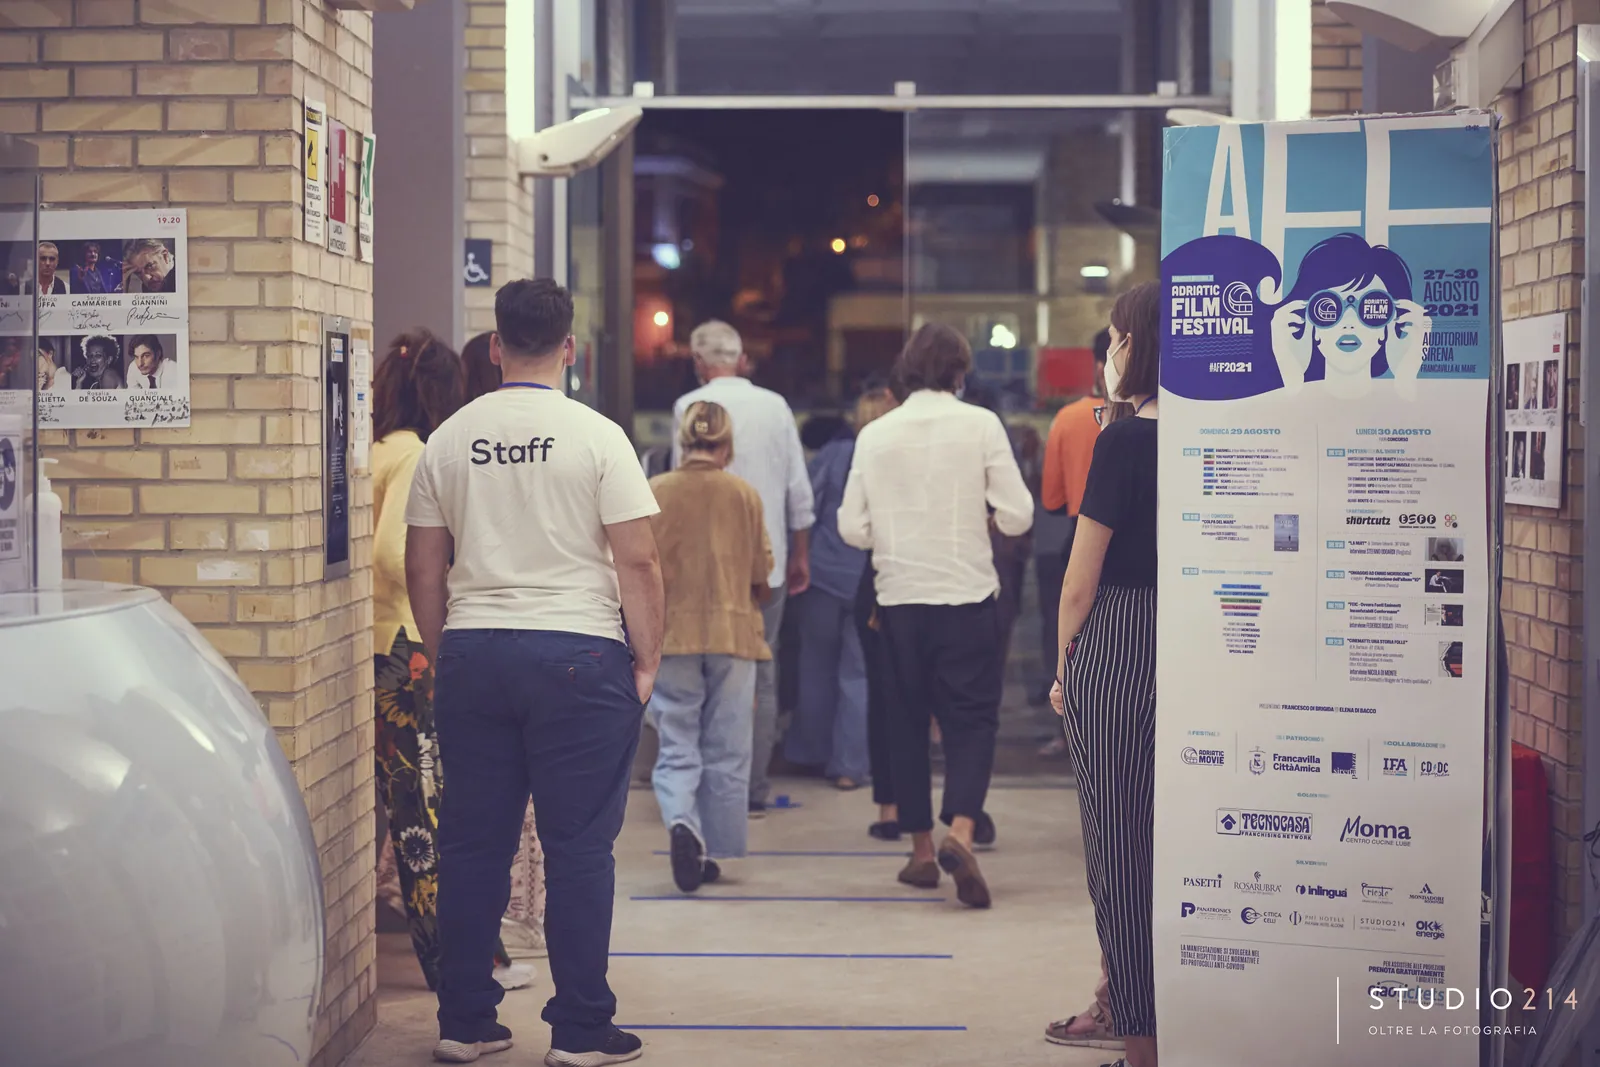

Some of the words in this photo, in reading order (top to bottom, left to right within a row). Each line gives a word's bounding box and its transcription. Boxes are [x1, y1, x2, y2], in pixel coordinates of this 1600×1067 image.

[1172, 285, 1220, 296] ADRIATIC
[1424, 281, 1479, 303] AGOSTO
[1172, 297, 1220, 317] FILM
[1364, 304, 1389, 314] FILM
[1423, 304, 1479, 316] 2021
[1171, 317, 1254, 335] FESTIVAL
[1422, 331, 1478, 347] AUDITORIUM
[1421, 347, 1454, 361] SIRENA
[470, 436, 556, 466] Staff
[1346, 516, 1391, 525] shortcutz
[1199, 750, 1225, 758] ADRIATIC
[1272, 754, 1320, 764] Francavilla
[1199, 757, 1225, 765] MOVIE
[1383, 758, 1408, 771] IFA
[1272, 762, 1320, 773] CittàAmica
[1241, 812, 1312, 834] TECNOCASA
[1340, 815, 1411, 842] Moma
[1346, 837, 1370, 845] CENTRO
[1183, 874, 1222, 889] PASETTI
[1234, 881, 1281, 892] ROSARUBRA
[1308, 885, 1347, 899] inlingua
[1409, 894, 1444, 902] MONDADORI
[1196, 906, 1232, 914] PANATRONICS
[1360, 917, 1405, 927] STUDIO214
[1416, 920, 1433, 931] OK
[1416, 930, 1445, 940] energie
[1186, 944, 1223, 954] MANIFESTAZIONE
[1368, 966, 1395, 974] PRENOTA
[1395, 968, 1445, 978] GRATUITAMENTE
